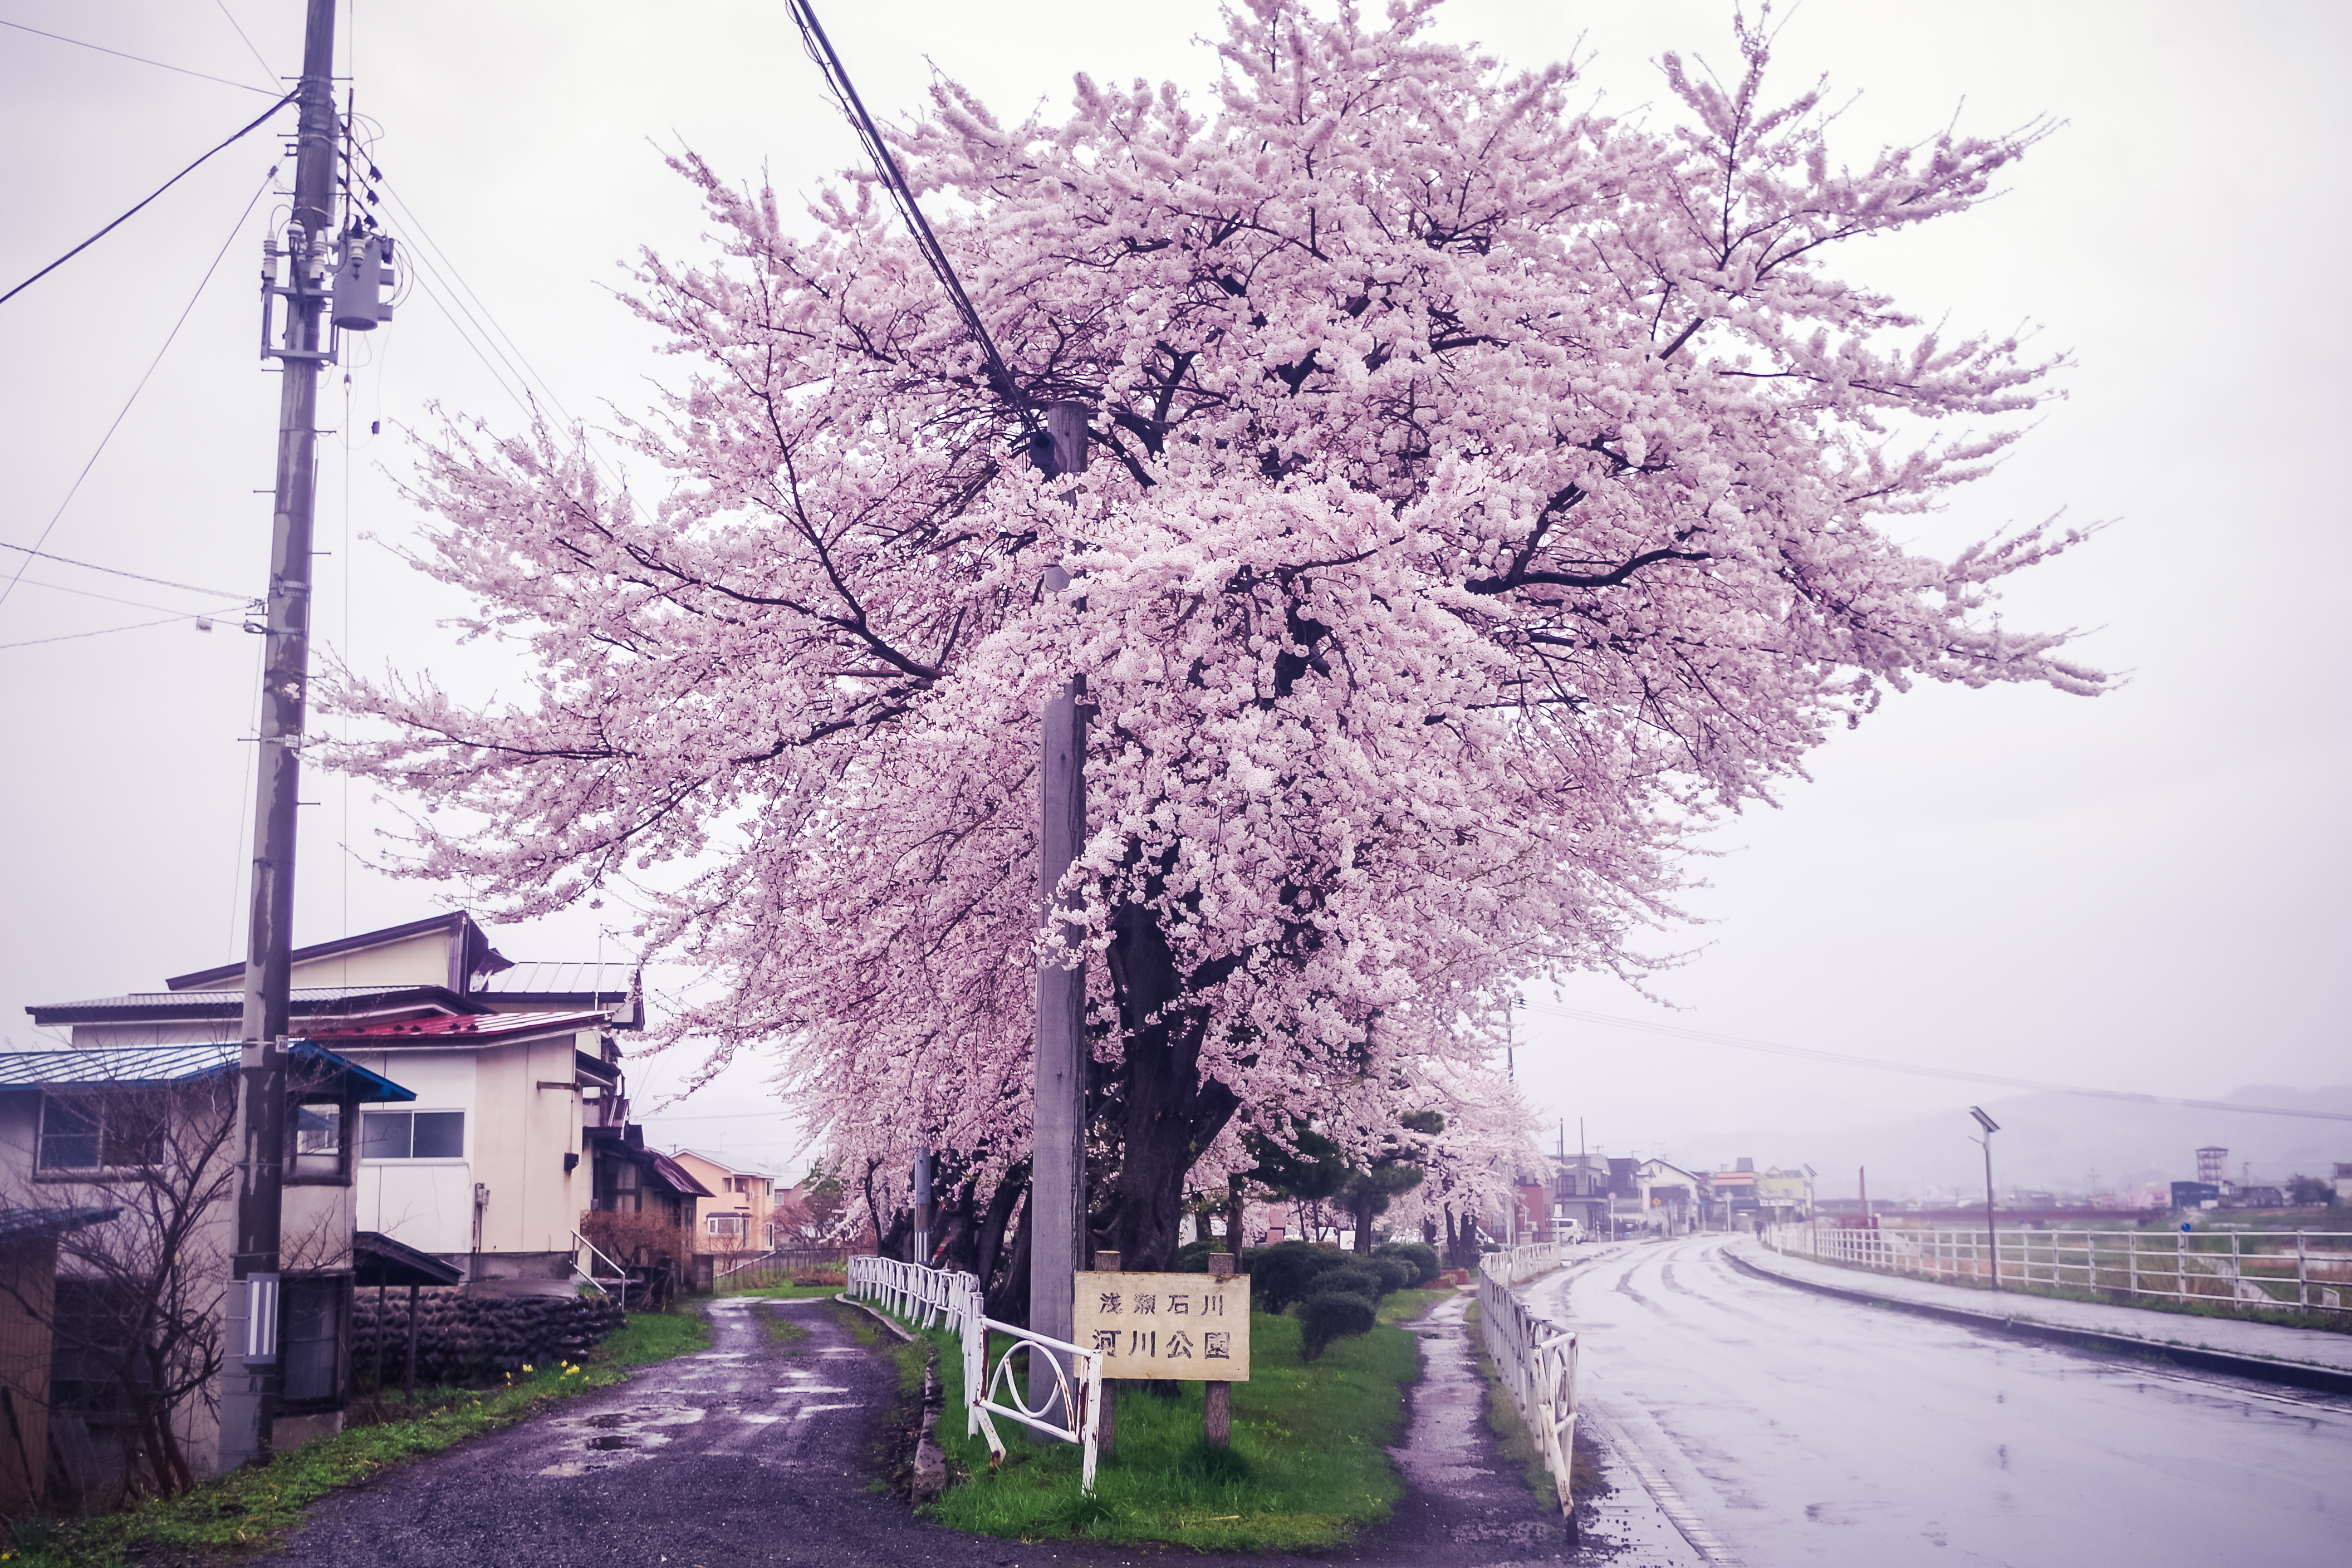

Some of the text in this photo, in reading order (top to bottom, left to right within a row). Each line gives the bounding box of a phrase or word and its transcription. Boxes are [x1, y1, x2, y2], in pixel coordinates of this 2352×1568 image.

[1100, 1292, 1223, 1316] 浅瀬石川
[1092, 1329, 1229, 1359] 河川公園
